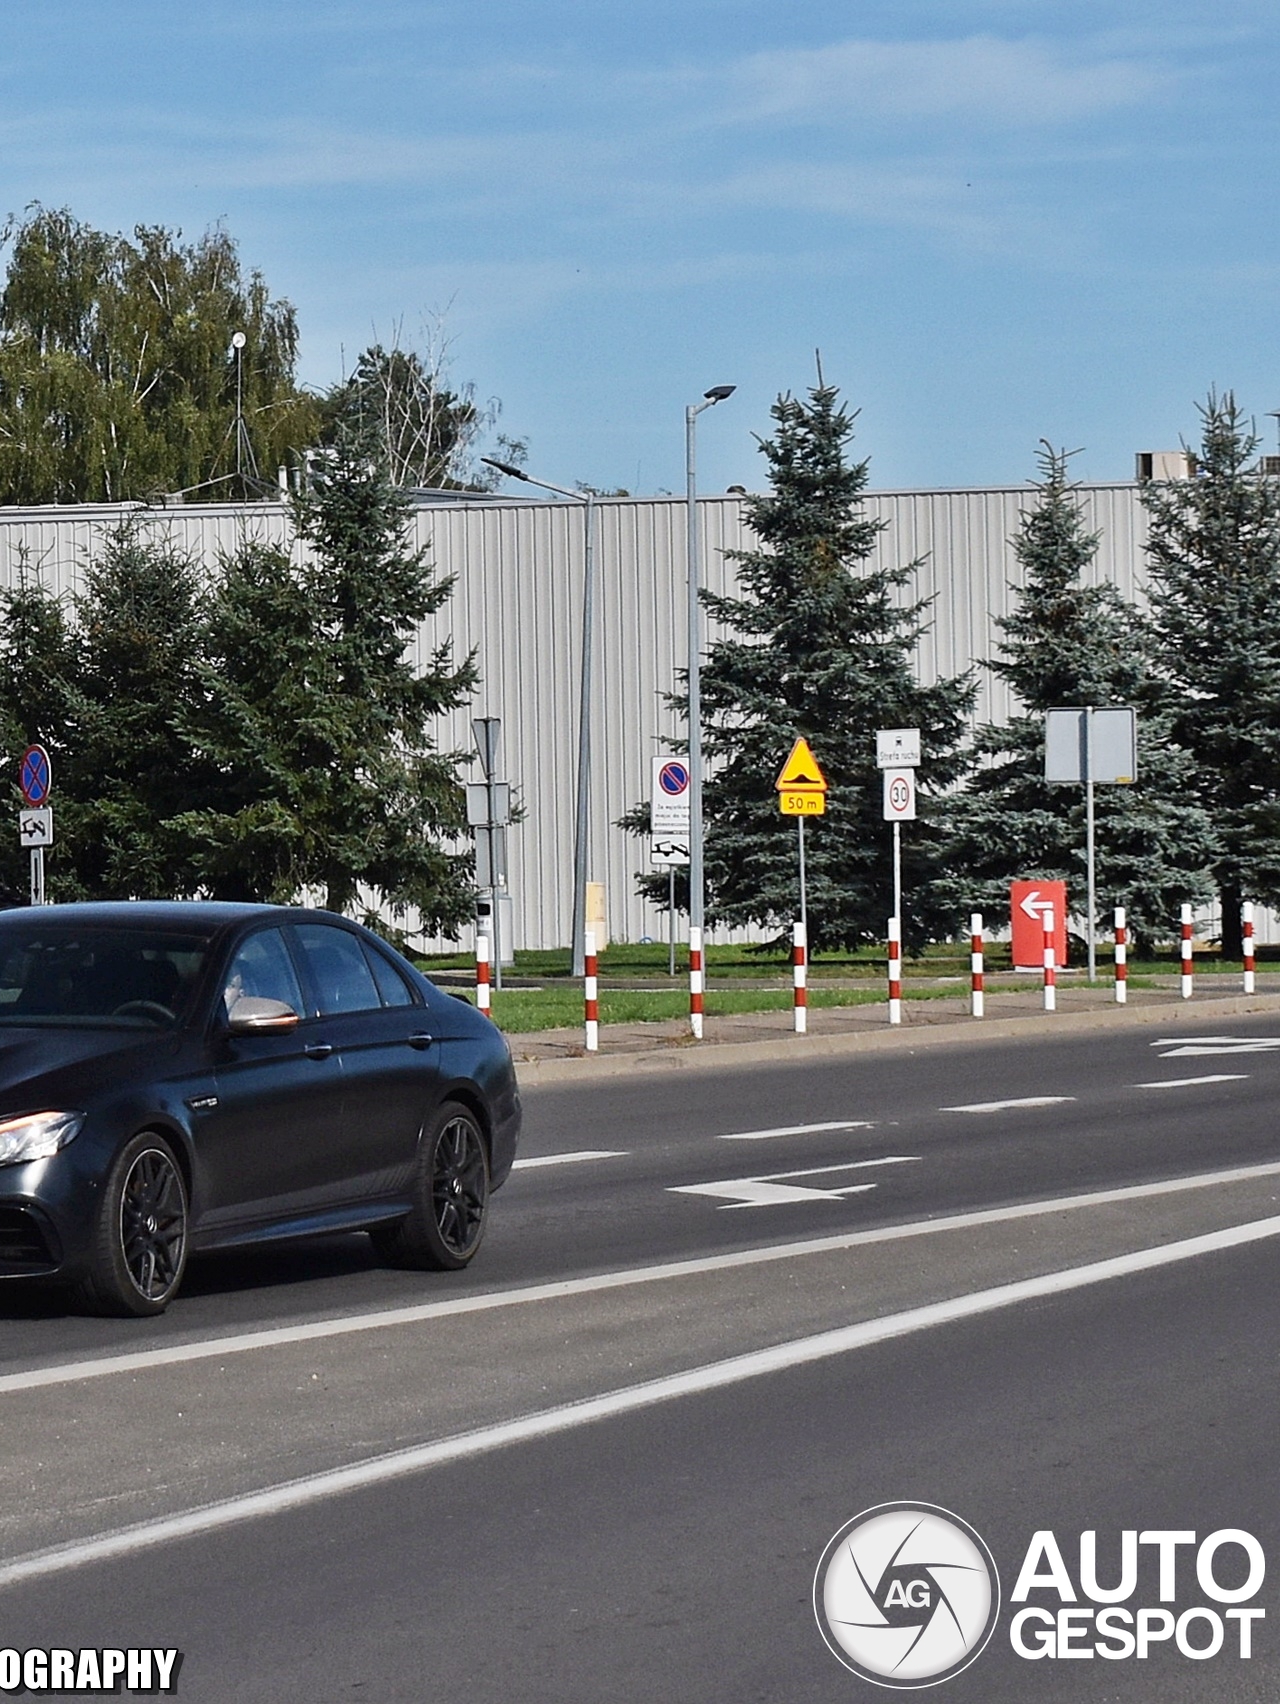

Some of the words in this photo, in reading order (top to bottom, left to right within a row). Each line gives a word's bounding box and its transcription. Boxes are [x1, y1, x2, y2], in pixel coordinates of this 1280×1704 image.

[893, 786, 907, 803] 30
[788, 797, 804, 810] 50
[806, 799, 817, 810] m
